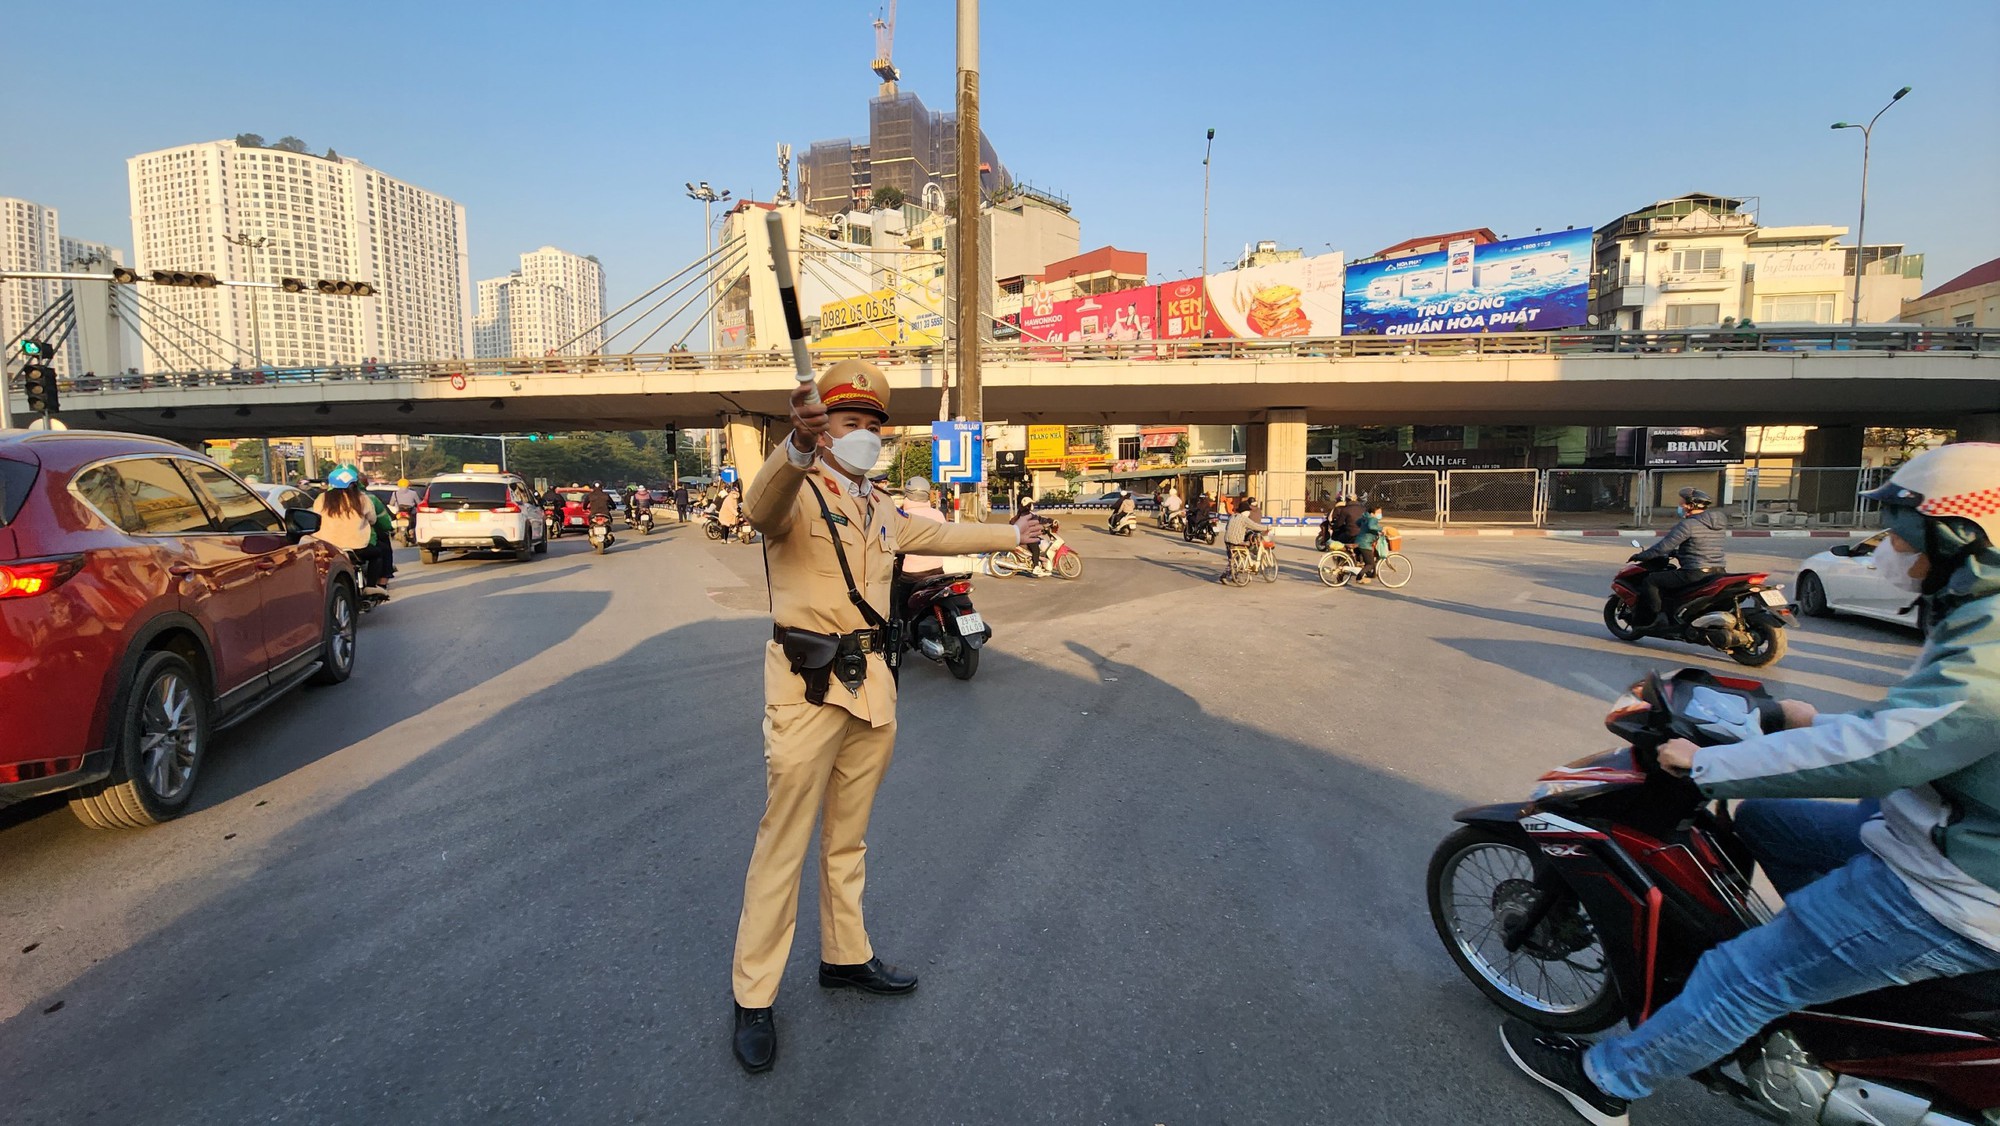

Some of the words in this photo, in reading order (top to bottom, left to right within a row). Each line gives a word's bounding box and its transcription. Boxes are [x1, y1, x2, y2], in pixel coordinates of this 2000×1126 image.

[822, 307, 847, 328] 0982
[849, 303, 862, 323] 05
[865, 300, 879, 319] 05
[881, 297, 896, 316] 05
[1168, 297, 1202, 317] KEN
[1453, 296, 1506, 313] ĐÔNG
[1024, 315, 1063, 327] HAWONKOO
[1183, 314, 1202, 335] JU
[1385, 317, 1444, 336] CHUẨN
[1447, 314, 1486, 330] HÒA
[1489, 308, 1541, 326] PHÁT
[1667, 439, 1729, 452] BRANDK
[1402, 453, 1445, 467] XANH
